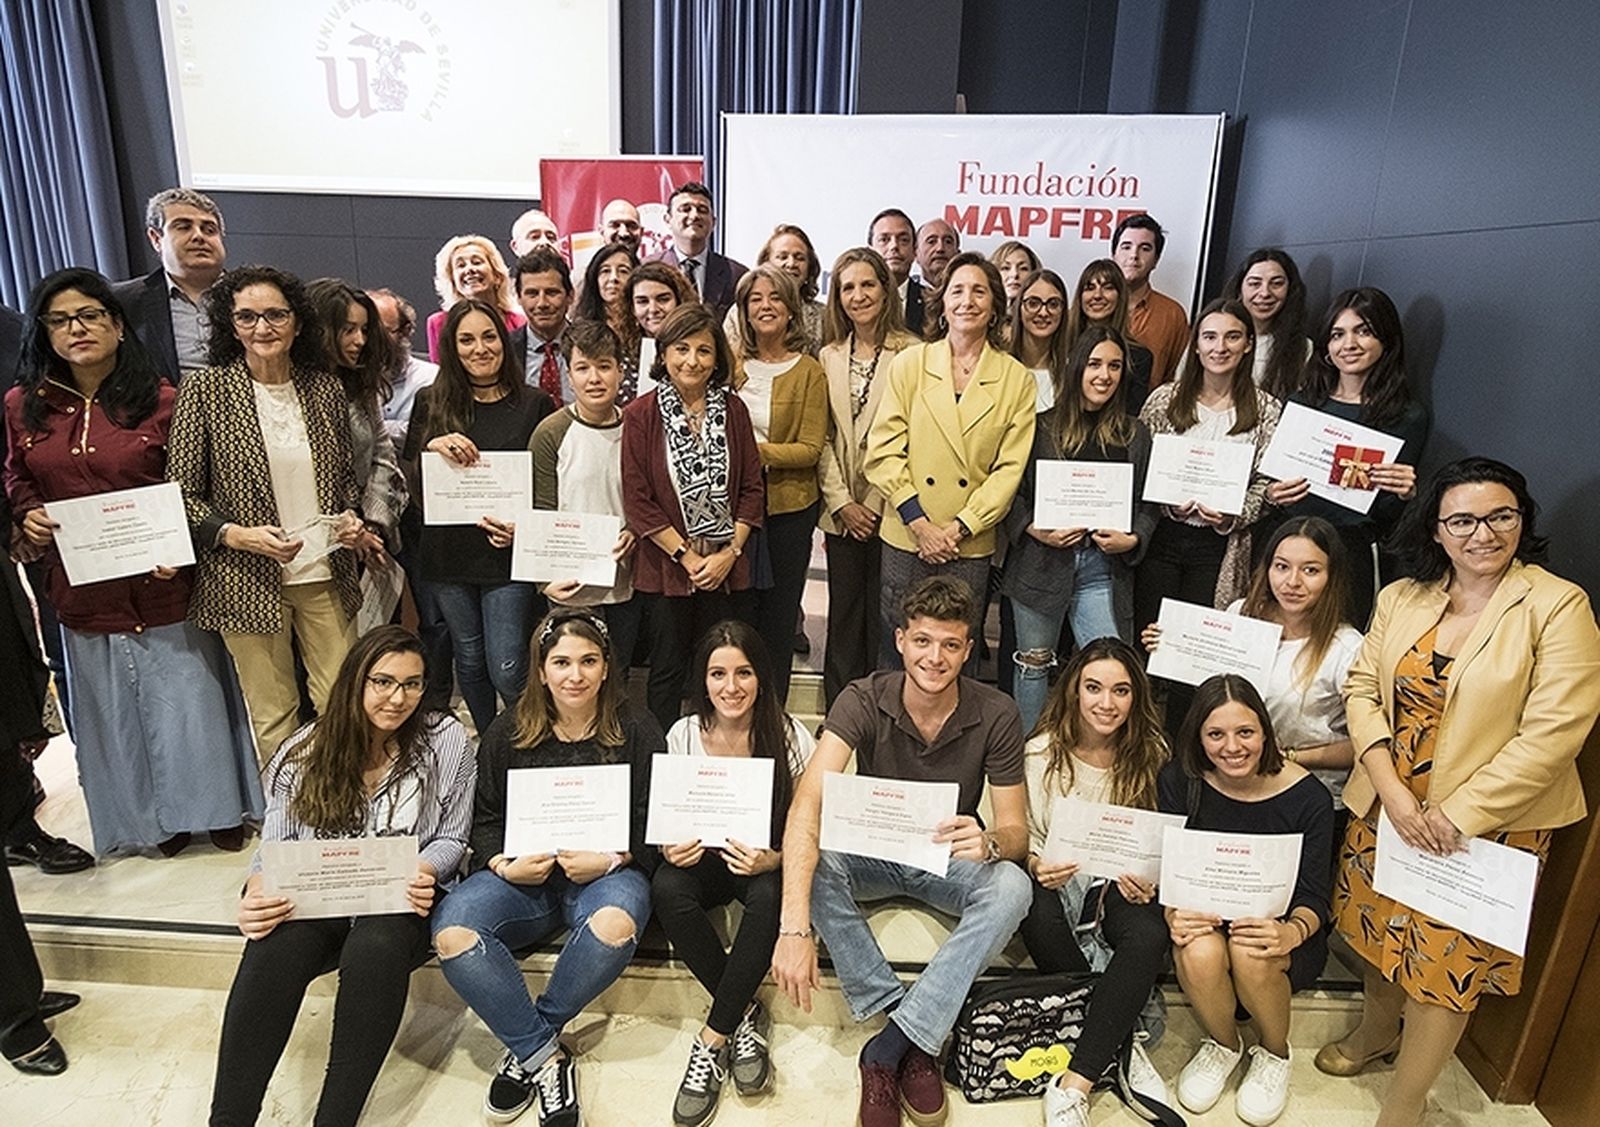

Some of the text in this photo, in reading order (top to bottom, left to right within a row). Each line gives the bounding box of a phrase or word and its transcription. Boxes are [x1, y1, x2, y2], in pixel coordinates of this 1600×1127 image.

[419, 11, 441, 37] DE
[419, 44, 451, 122] SEVILLA
[956, 161, 1139, 198] Fundación
